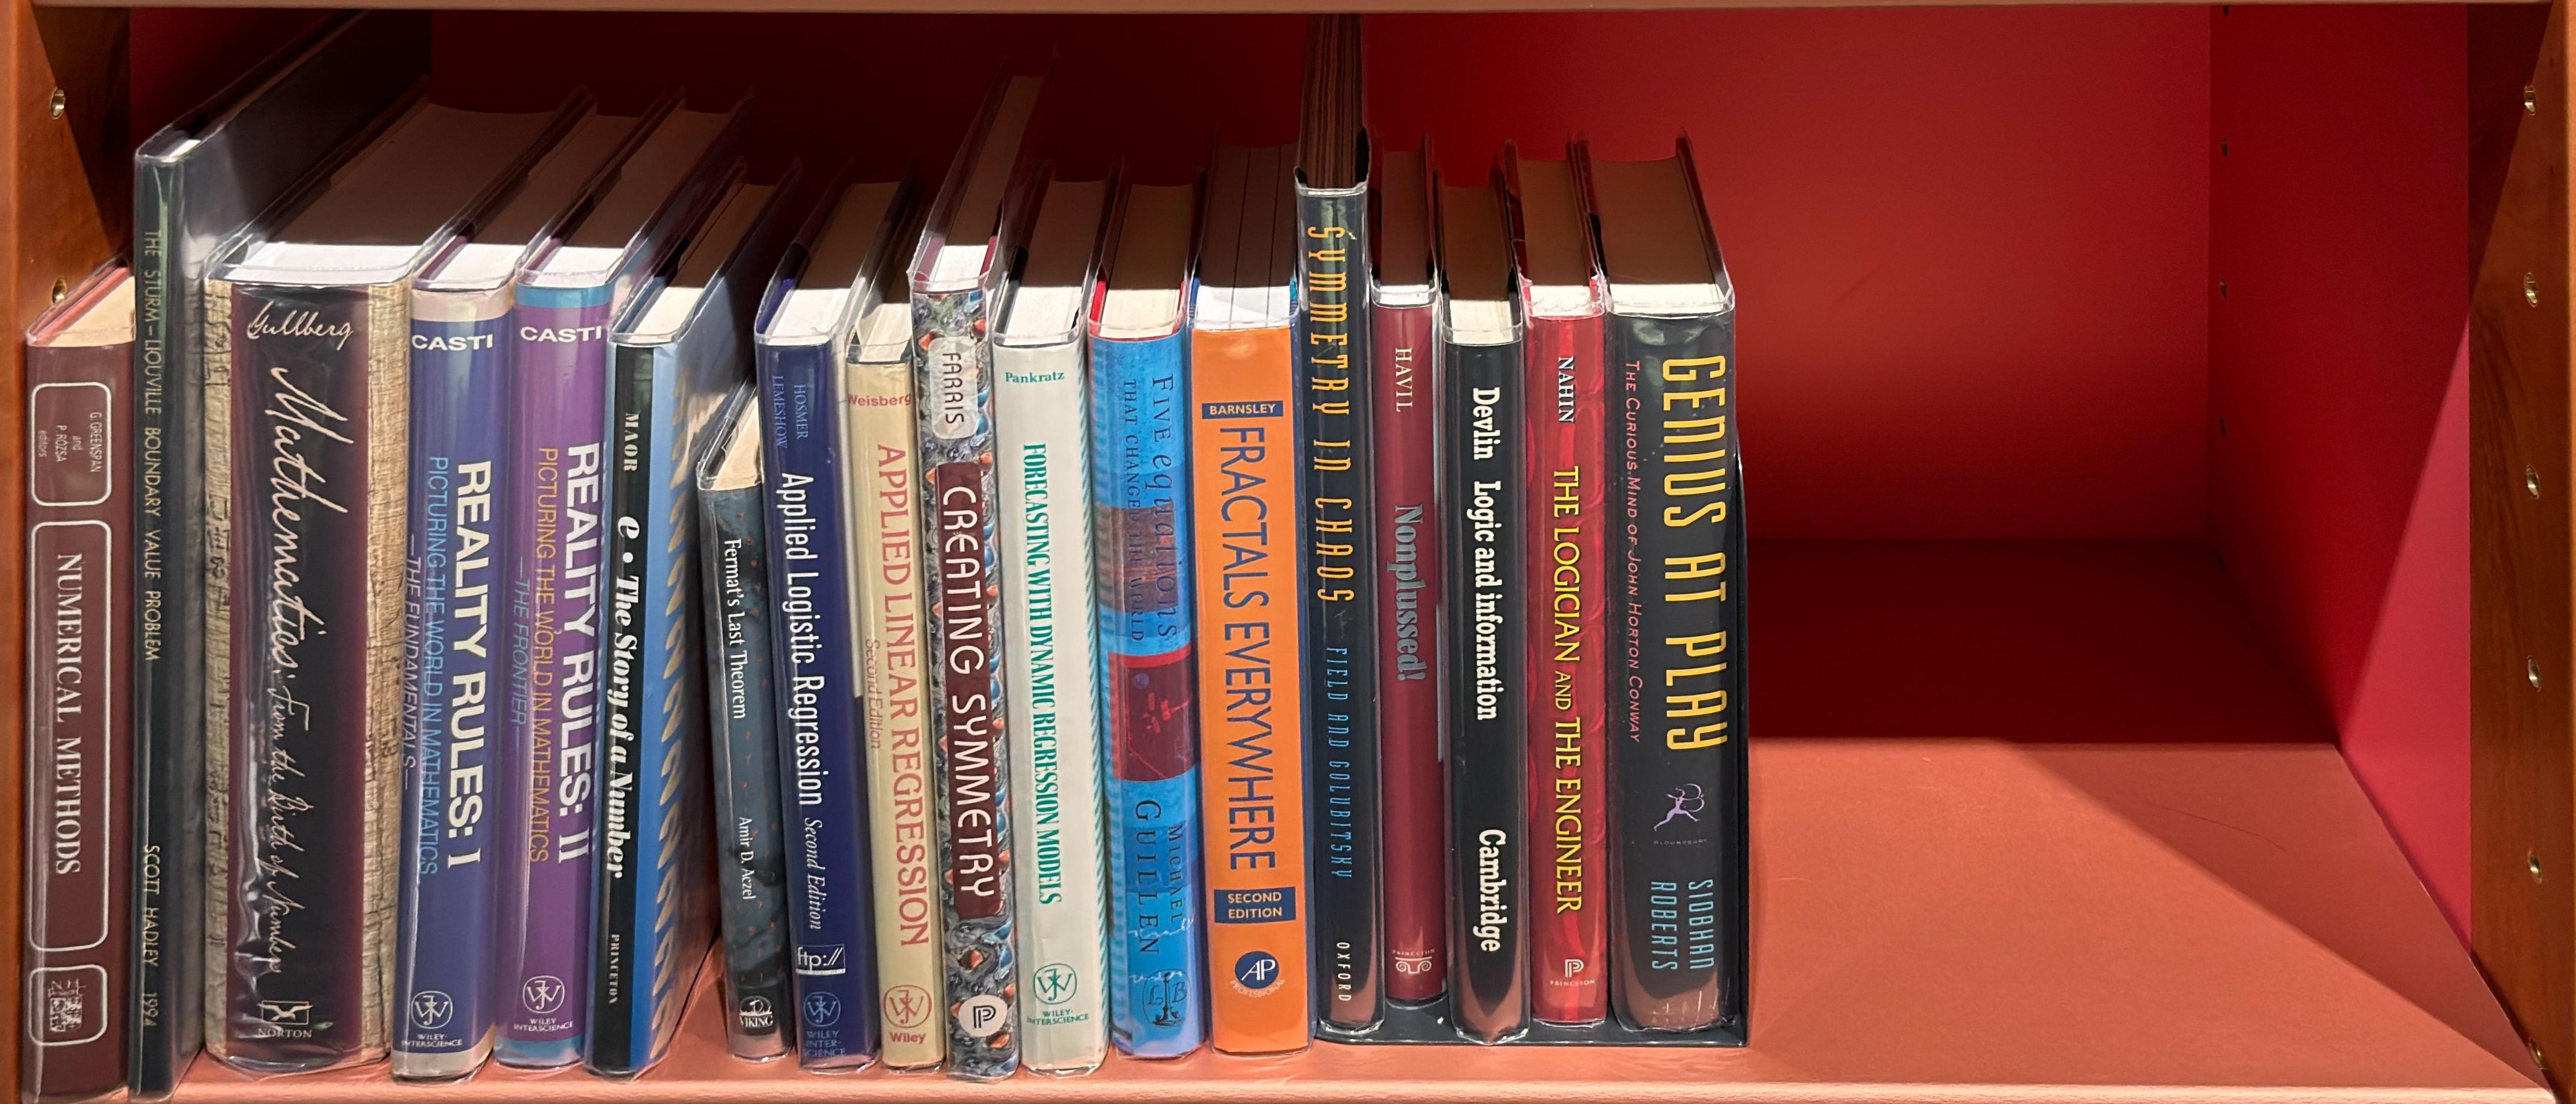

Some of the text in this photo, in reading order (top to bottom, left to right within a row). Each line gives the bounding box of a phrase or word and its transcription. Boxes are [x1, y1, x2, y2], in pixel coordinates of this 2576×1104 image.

[144, 230, 162, 256] THE
[247, 299, 354, 351] Gullberg
[411, 333, 494, 352] CASTI
[519, 325, 602, 343] CASTI
[772, 375, 788, 449] LEMESHOW
[793, 384, 809, 440] HOSMER
[847, 392, 912, 406] Weisberg
[942, 352, 964, 425] FARRIS
[1004, 371, 1065, 384] Pankratz
[1209, 403, 1277, 415] BARNSLEY
[1395, 347, 1413, 413] HAVIL
[1557, 356, 1575, 423] NAHIN
[38, 430, 50, 458] editors
[72, 435, 84, 451] and
[89, 412, 103, 472] G. GREENSPAN
[624, 412, 640, 471] MAOR
[1307, 226, 1355, 601] SYMMETRY IN CHAOS
[144, 427, 162, 516] BOUNDARY
[1144, 374, 1183, 638] FIVE equations
[265, 367, 355, 679] Mathematics:
[1123, 379, 1144, 642] THAT CHANGED THE WORLD
[144, 529, 161, 578] VALUE
[1466, 387, 1504, 720] Devlin Logic and information
[1662, 355, 1728, 750] GENIUS AT PLAY
[145, 590, 162, 661] PROBLEM
[1386, 504, 1428, 681] Nonplussed!
[530, 448, 558, 862] PICTURING THE WORLD IN MATHEMATICS
[558, 442, 600, 864] REALITY RULES: II
[724, 538, 749, 719] Fermat's Last Theorem
[1220, 427, 1275, 870] FRACTALS EVERYWHERE
[419, 456, 449, 874] PICTURING THE WORLD IN MATHEMATICS
[448, 460, 491, 869] REALITY RULES: I
[606, 516, 640, 879] e The Story of a Number
[865, 638, 884, 749] Second Edition
[877, 444, 929, 947] APPLIED LINEAR REGRESSION
[943, 486, 994, 897] CREATING SYMMETRY
[1023, 443, 1062, 904] FORECASTING WITH DYNAMIC REGRESSION MODELS
[1553, 466, 1583, 915] THE LOGICIAN AND THE ENGINEER
[55, 552, 83, 875] NUMERICAL METHODS
[267, 685, 309, 740] From
[776, 473, 829, 930] Applied Logistic Regression Second Edition
[270, 746, 305, 783] the
[1327, 647, 1352, 878] FIELD AND GOLUBITSKY
[268, 790, 314, 850] Birth
[259, 855, 300, 877] of
[739, 817, 756, 900] Amir D. Aczel
[1135, 799, 1162, 955] GUILLEN
[1167, 825, 1183, 924] MICHAEL
[1473, 829, 1508, 952] Cambridge
[142, 844, 160, 967] SCOTT HADLEY
[1227, 892, 1282, 904] SECOND
[1228, 907, 1283, 920] EDITION
[1650, 881, 1678, 970] ROBERTS
[1688, 879, 1715, 970] SIOBHAN
[608, 934, 620, 1004] PRINCETON
[798, 946, 844, 971] ftp://
[1240, 959, 1276, 981] AP
[1337, 942, 1352, 1002] OXFORD
[1392, 948, 1436, 956] PRINCETON
[140, 991, 158, 1027] 1994
[257, 1028, 312, 1038] NORTON
[513, 1020, 573, 1031] INTERSCIENCE
[740, 1016, 774, 1028] VIKING
[805, 1029, 840, 1039] WILEY
[889, 1031, 927, 1044] Wiley
[1027, 1013, 1089, 1025] INTERSCIENCE
